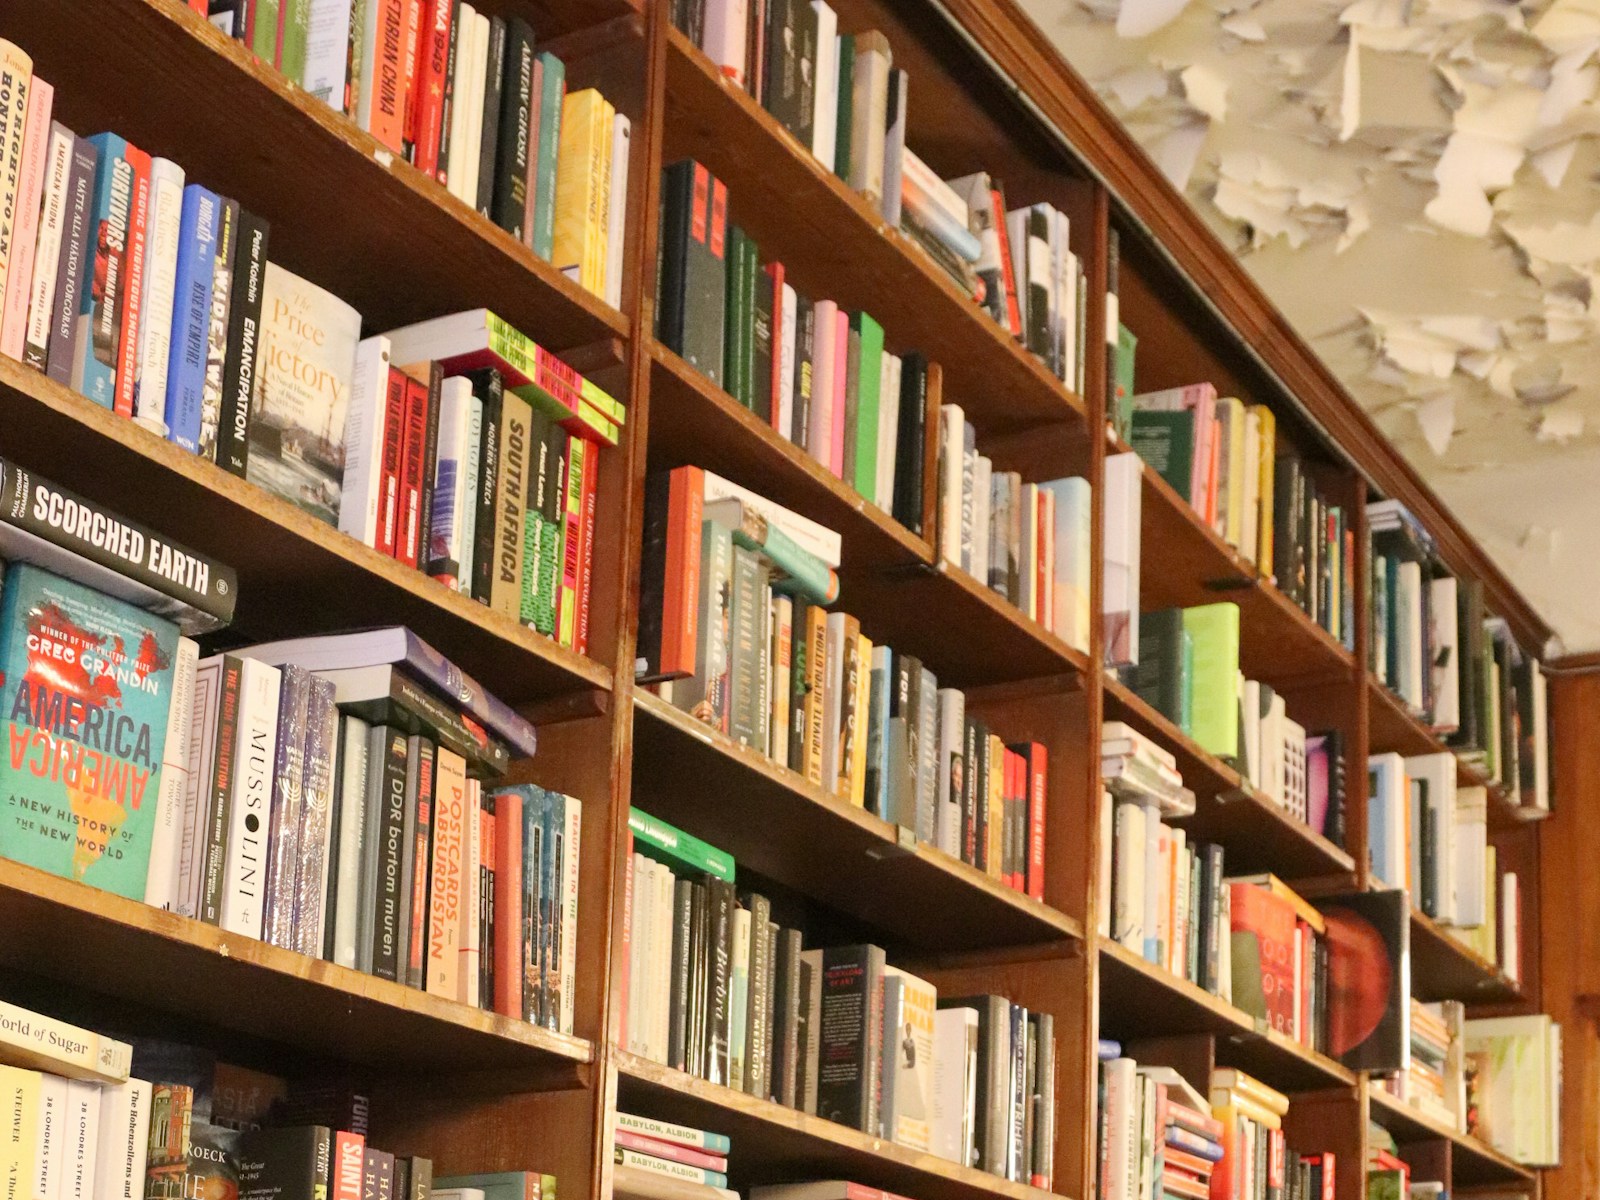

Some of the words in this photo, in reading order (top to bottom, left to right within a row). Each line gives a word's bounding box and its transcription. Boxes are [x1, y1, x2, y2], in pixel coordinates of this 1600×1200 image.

[17, 80, 26, 111] NO
[380, 65, 397, 116] CHINA
[519, 40, 531, 106] AMITAV
[8, 115, 22, 188] RIGHT
[516, 107, 528, 167] GHOSH
[54, 142, 66, 191] AMERICAN
[4, 192, 13, 219] TO
[48, 191, 59, 229] VISIONS
[105, 157, 131, 252] SURVIVORS
[253, 229, 262, 259] Peter
[105, 254, 118, 298] HANNAH
[129, 244, 144, 305] RIGHTEOUS
[248, 260, 259, 303] Kolchin
[102, 296, 114, 335] DURKIN
[272, 297, 325, 347] Price
[122, 306, 137, 401] SMOKESCREEN
[233, 317, 255, 442] EMANCIPATION
[485, 422, 495, 467] MODERN
[507, 418, 524, 489] SOUTH
[15, 467, 24, 498] THOMAS
[484, 470, 493, 505] AFRICA
[11, 498, 20, 517] PAUL
[33, 485, 145, 564] SCORCHED
[147, 537, 209, 596] EARTH
[501, 495, 520, 584] AFRICA
[585, 518, 594, 566] AFRICAN
[580, 567, 592, 641] REVOLUTION
[26, 634, 76, 664] GREG
[80, 653, 159, 696] GRANDIN
[40, 624, 68, 642] WINNER
[70, 635, 79, 645] OF
[81, 639, 94, 651] THE
[96, 645, 128, 663] PULITZER
[131, 658, 150, 672] PRIZE
[815, 624, 825, 705] REVOLUTIONS
[227, 669, 238, 689] THE
[224, 692, 235, 722] IRISH
[811, 707, 823, 756] PRIVATE
[217, 723, 232, 790] REVOLUTION
[20, 797, 52, 815] NEW
[56, 809, 117, 837] HISTORY
[122, 831, 133, 843] OF
[391, 779, 404, 821] DDR
[16, 817, 34, 830] THE
[40, 827, 70, 842] NEW
[76, 837, 123, 860] WORLD
[386, 826, 402, 893] bortom
[447, 785, 463, 922] POSTCARDS
[431, 799, 449, 959] ABSURDISTAN
[383, 899, 394, 956] muren
[715, 946, 728, 1021] Barbra
[34, 1028, 46, 1040] of
[48, 1030, 88, 1055] Sugar
[12, 1087, 23, 1143] STEUWER
[45, 1096, 53, 1108] 38
[80, 1101, 88, 1114] 38
[131, 1089, 140, 1108] The
[42, 1111, 52, 1155] LONDRES
[77, 1115, 87, 1161] LONDRES
[125, 1110, 139, 1179] Hohenzollerns
[619, 1117, 663, 1134] BABYLON,
[665, 1128, 697, 1141] ALBION
[39, 1159, 49, 1195] STREET
[73, 1164, 83, 1200] STREET
[630, 1156, 670, 1172] BABYLON,
[670, 1166, 700, 1180] ALBION
